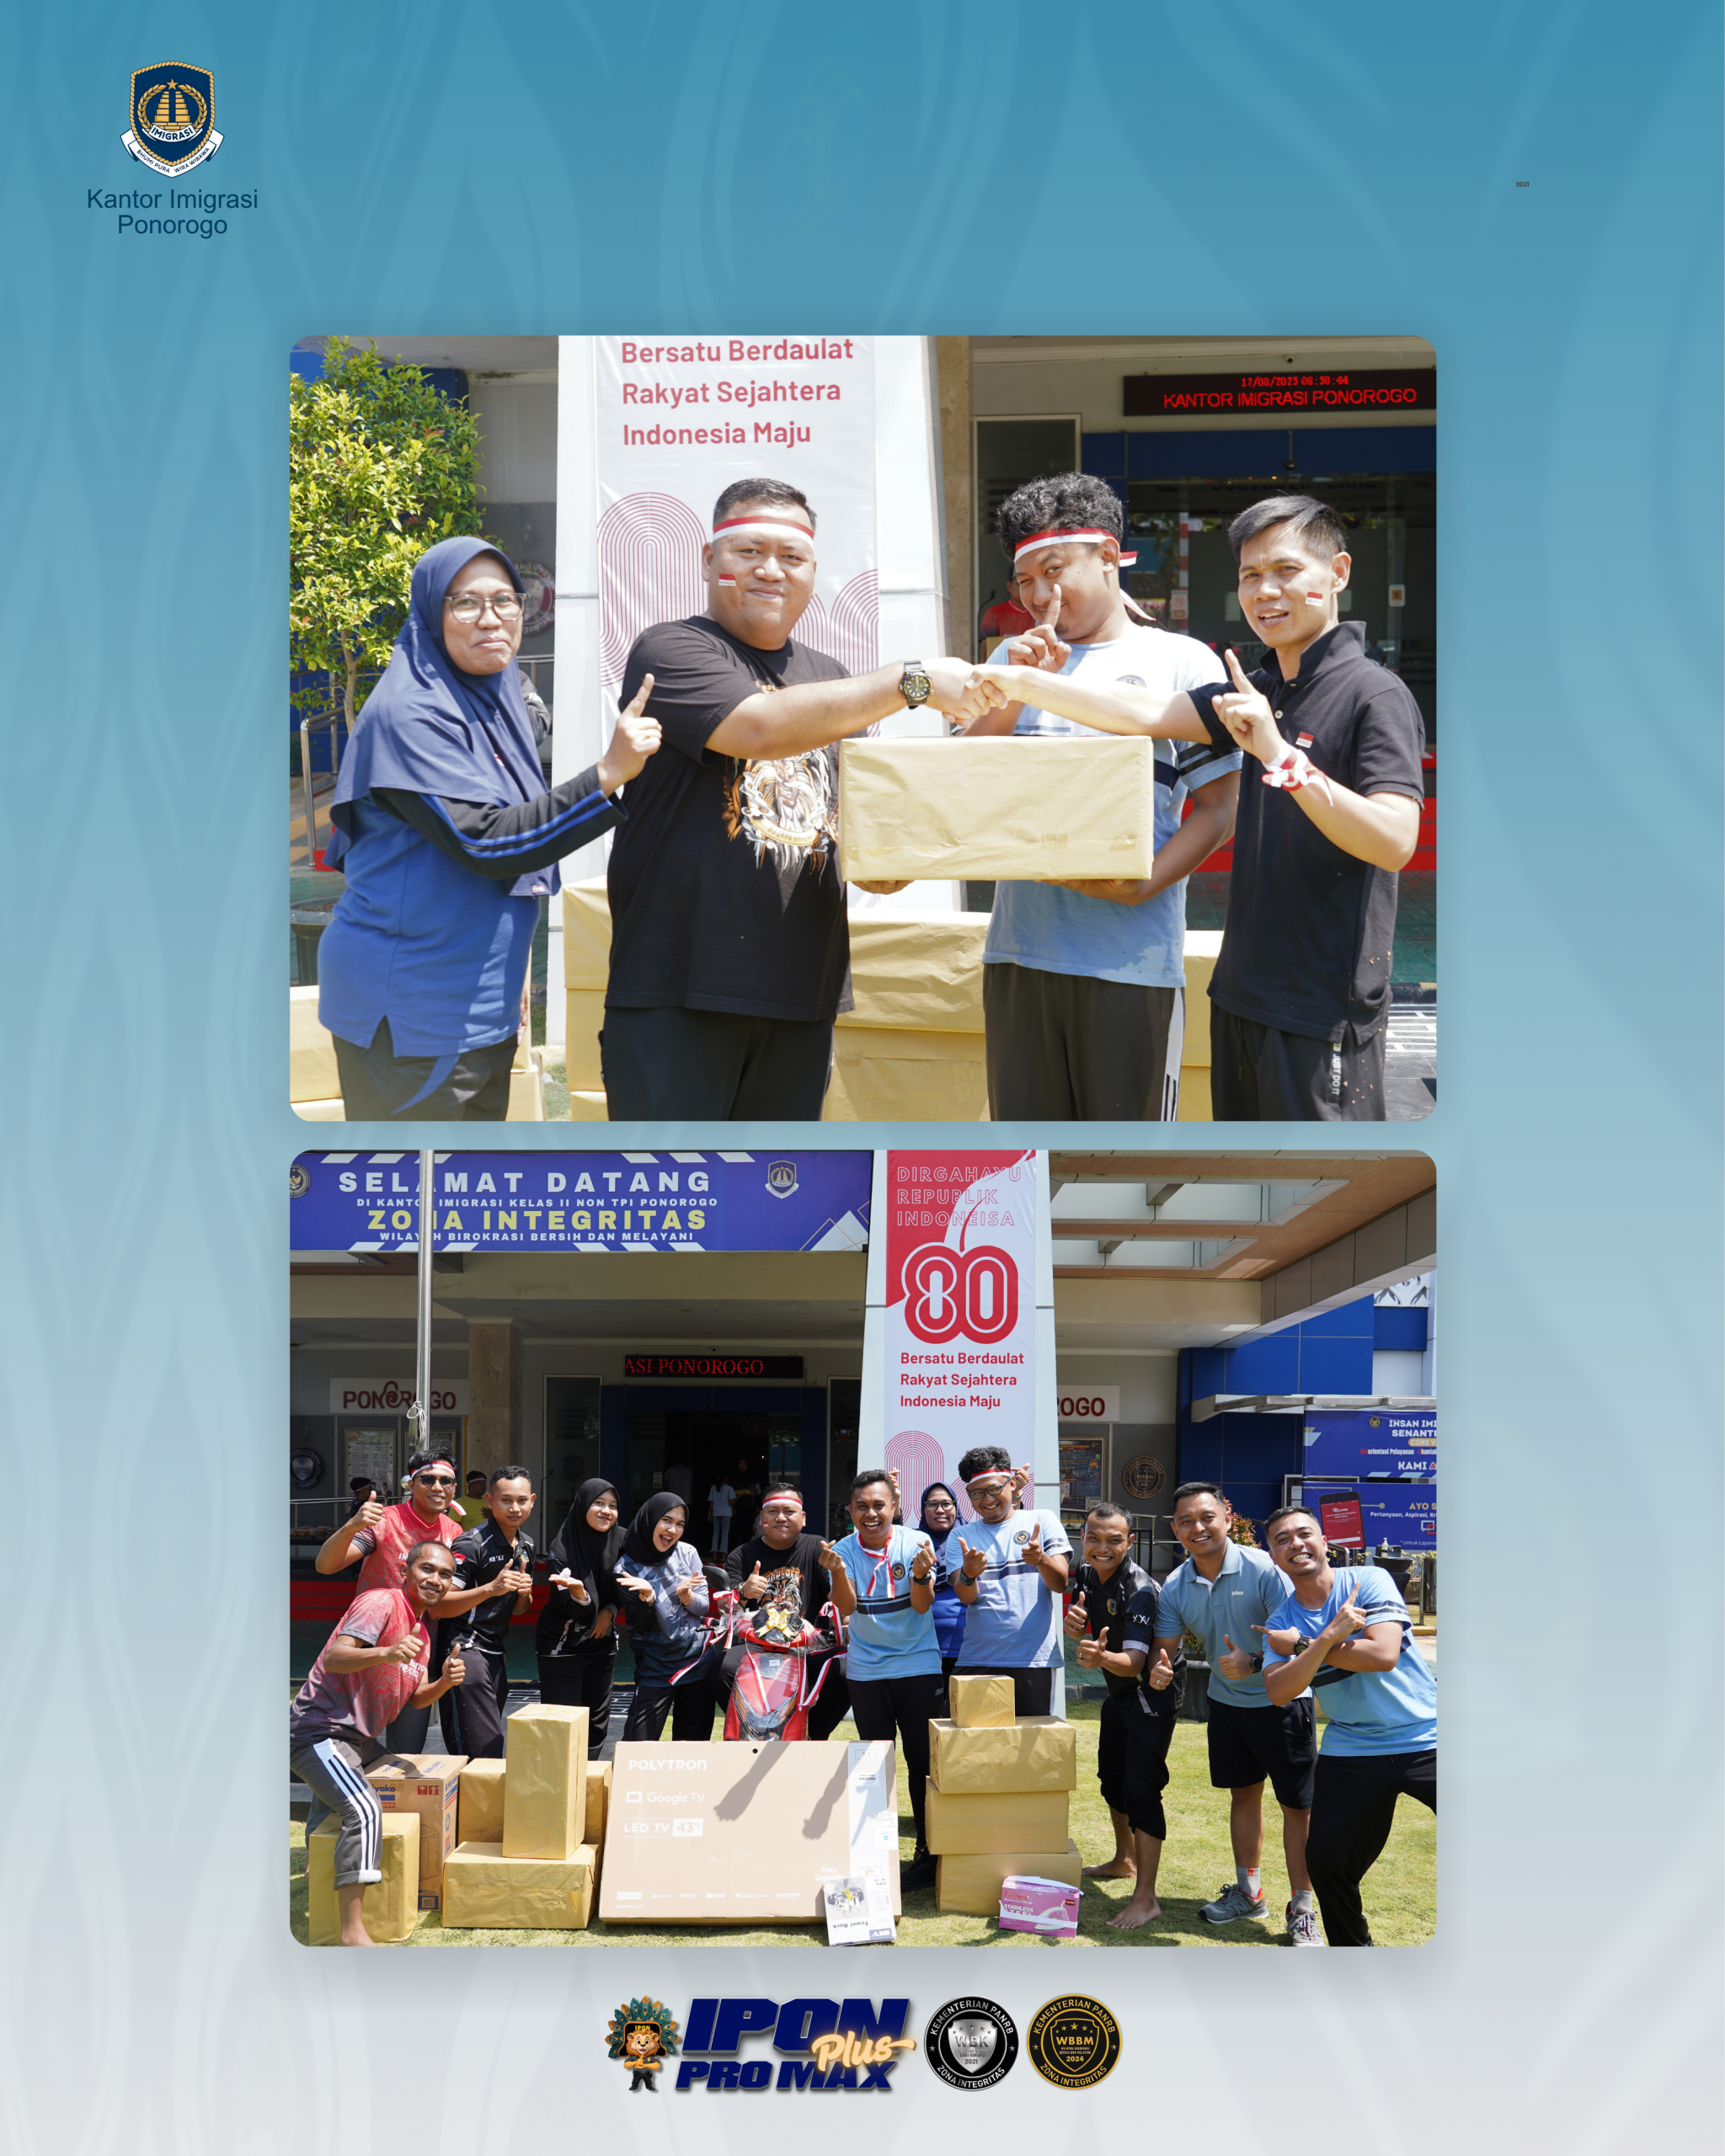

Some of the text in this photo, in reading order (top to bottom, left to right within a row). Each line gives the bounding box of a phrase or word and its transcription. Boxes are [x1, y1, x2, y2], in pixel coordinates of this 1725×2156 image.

[622, 338, 853, 363] Bersatu Berdaulat
[622, 380, 841, 409] Rakyat Sejahtera
[1163, 388, 1417, 408] KANTOR IMIGRASI PONOROGO
[624, 421, 810, 448] Indonesia Maju
[1332, 1054, 1341, 1074] JUST
[1332, 1075, 1341, 1087] DO
[547, 1171, 709, 1193] DATANG
[377, 1198, 419, 1207] KANTO
[439, 1198, 503, 1207] IMIGRASI
[510, 1198, 553, 1207] KELAS
[576, 1198, 605, 1207] NON
[611, 1198, 633, 1207] TPI
[640, 1198, 718, 1207] PONOROGO
[897, 1188, 999, 1204] REPUBLIK
[367, 1209, 706, 1230] ZOA INTEGRITAS
[897, 1211, 1015, 1226] INDONEISA
[380, 1232, 693, 1241] WILAYH BIROKRASI BERSIH DAN MELAYANI
[902, 1242, 1018, 1344] 80
[658, 1358, 764, 1374] PONOROGO
[900, 1353, 1024, 1364] Bersatu Berdaulat
[900, 1374, 1017, 1389] Rakyat Sejahtera
[343, 1380, 456, 1410] PONORGO
[900, 1395, 1001, 1410] Indonesia Maju
[1398, 1461, 1428, 1470] KAMI
[647, 1791, 705, 1806] Google TV
[624, 1822, 649, 1833] LED
[653, 1822, 670, 1833] TV
[1004, 1890, 1027, 1901] Cosmos
[1003, 1904, 1033, 1913] STAINLESS
